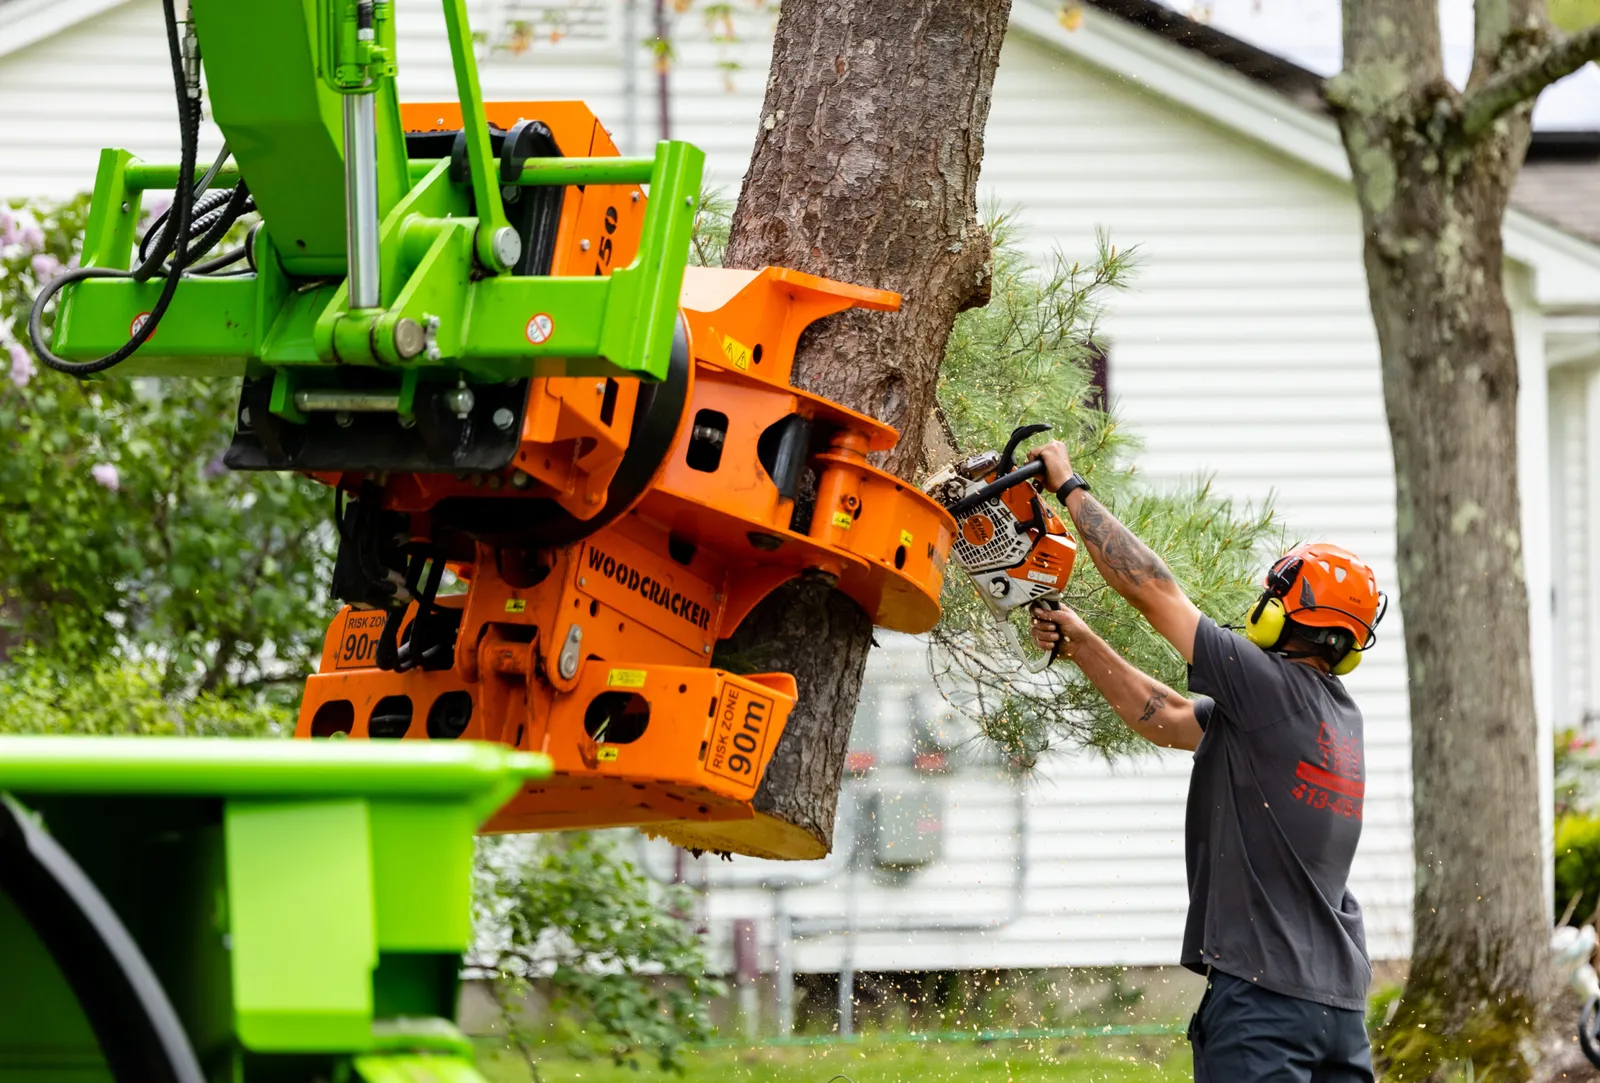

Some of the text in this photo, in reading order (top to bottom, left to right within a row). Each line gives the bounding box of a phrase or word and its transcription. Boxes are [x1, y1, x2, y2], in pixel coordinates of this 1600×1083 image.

[595, 205, 618, 276] 50
[971, 517, 989, 542] STIHL
[347, 615, 386, 629] RISK ZON
[588, 546, 711, 631] WOODCRACKER
[713, 689, 740, 769] RISK ZONE
[728, 700, 766, 775] 90m
